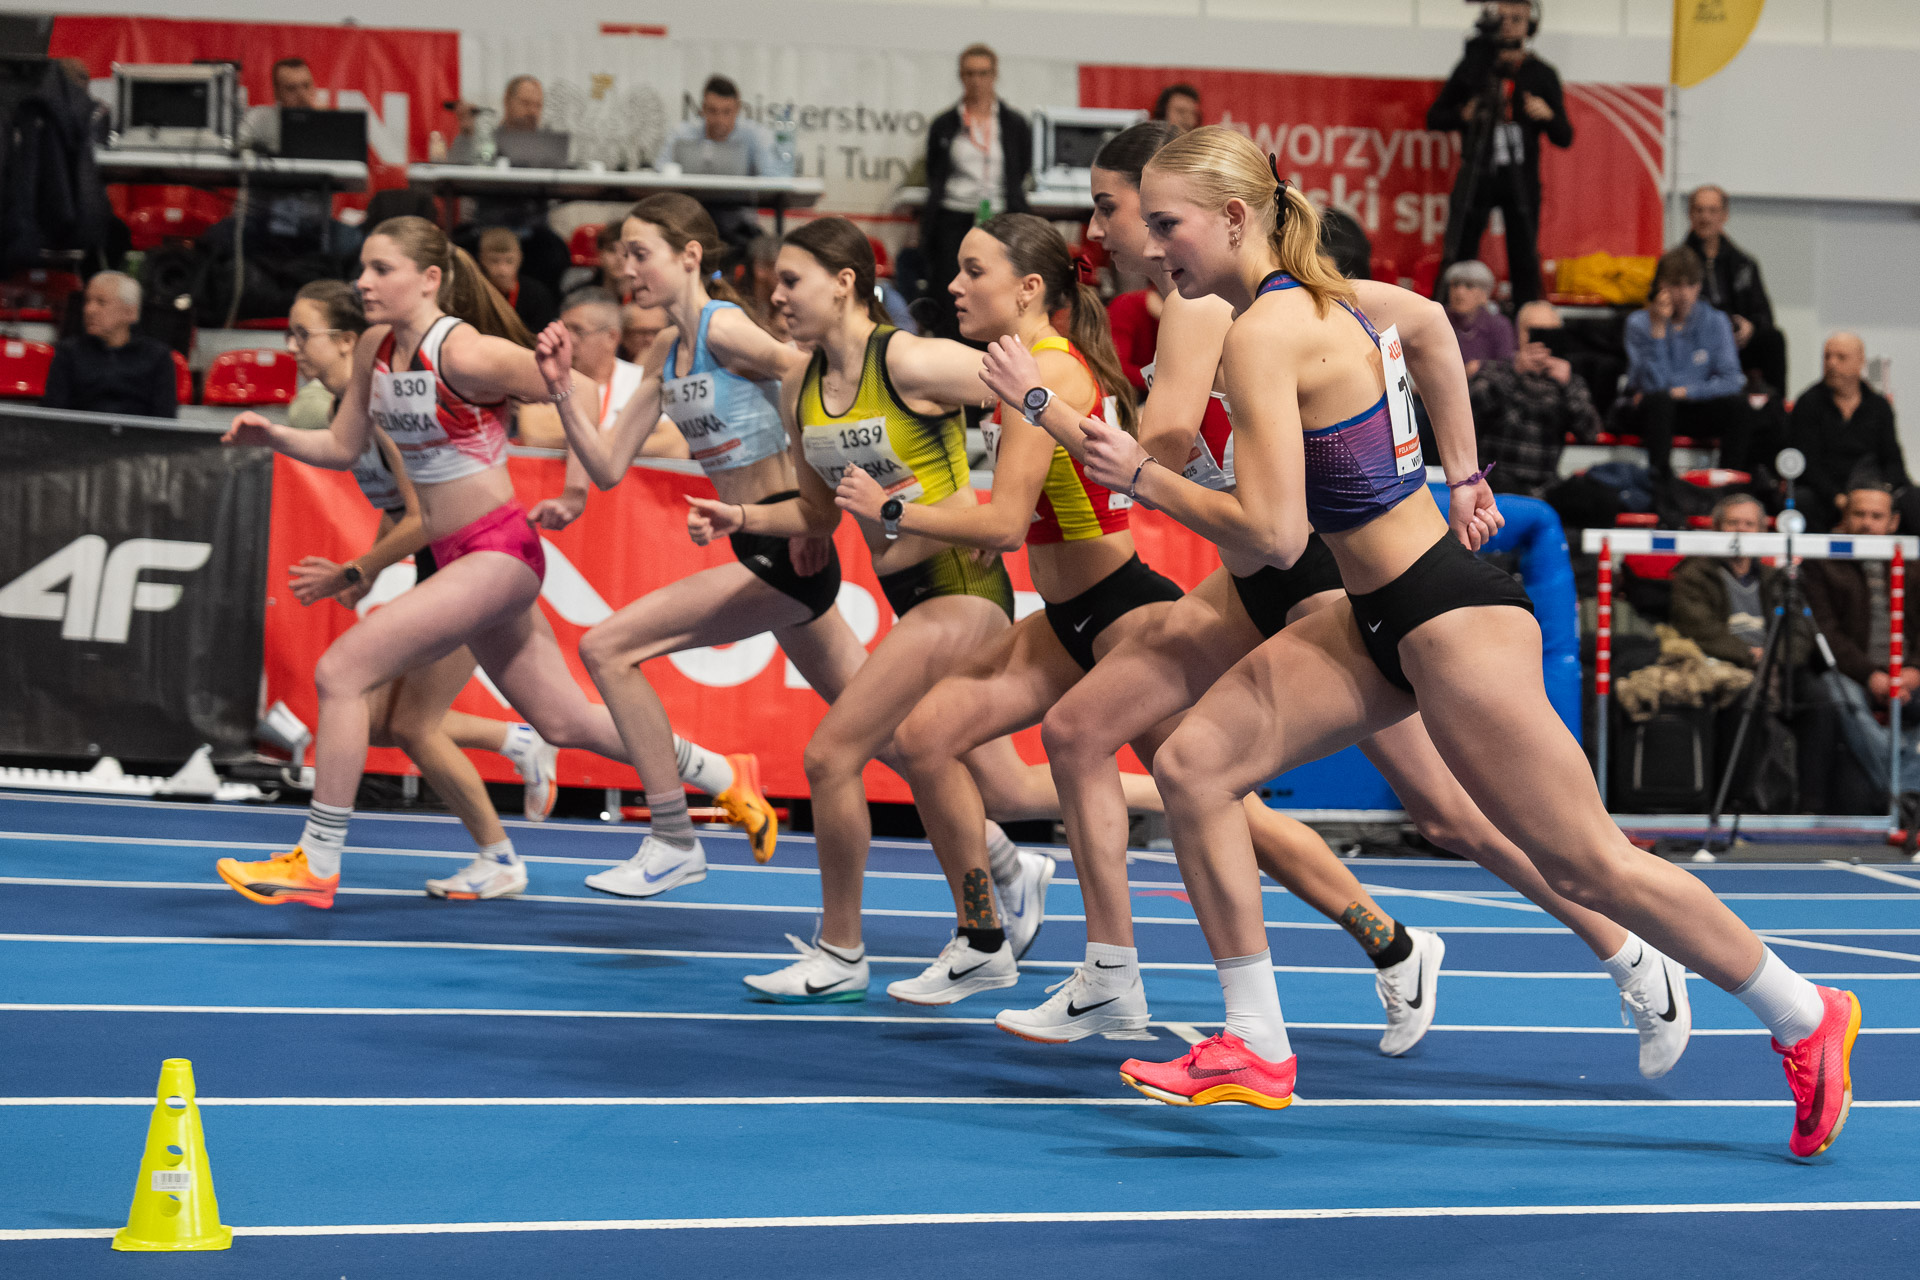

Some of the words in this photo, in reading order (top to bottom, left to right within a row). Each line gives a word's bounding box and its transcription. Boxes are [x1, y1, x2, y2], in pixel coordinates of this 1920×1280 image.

[393, 378, 427, 397] 830
[682, 380, 708, 402] 575
[839, 425, 882, 449] 1339
[0, 534, 212, 643] 4F
